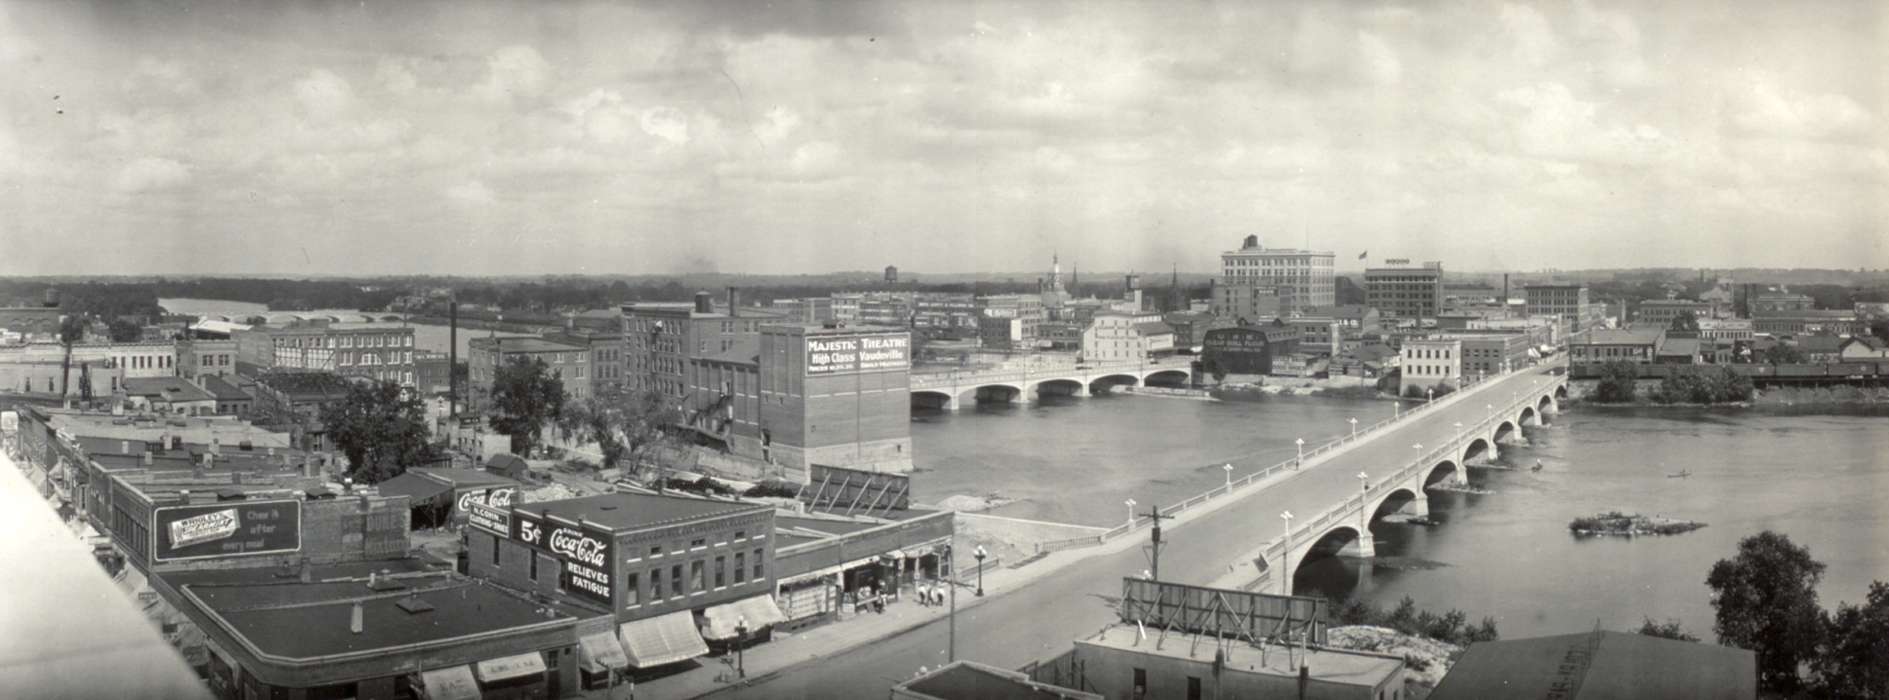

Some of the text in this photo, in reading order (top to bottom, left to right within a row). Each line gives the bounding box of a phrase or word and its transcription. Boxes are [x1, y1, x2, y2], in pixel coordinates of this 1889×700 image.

[808, 338, 908, 352] MAJESTIC THEATRE
[831, 352, 856, 363] Class
[859, 349, 904, 361] Vaudeville
[567, 561, 609, 584] RELIEVES
[572, 575, 610, 598] FATIGUE
